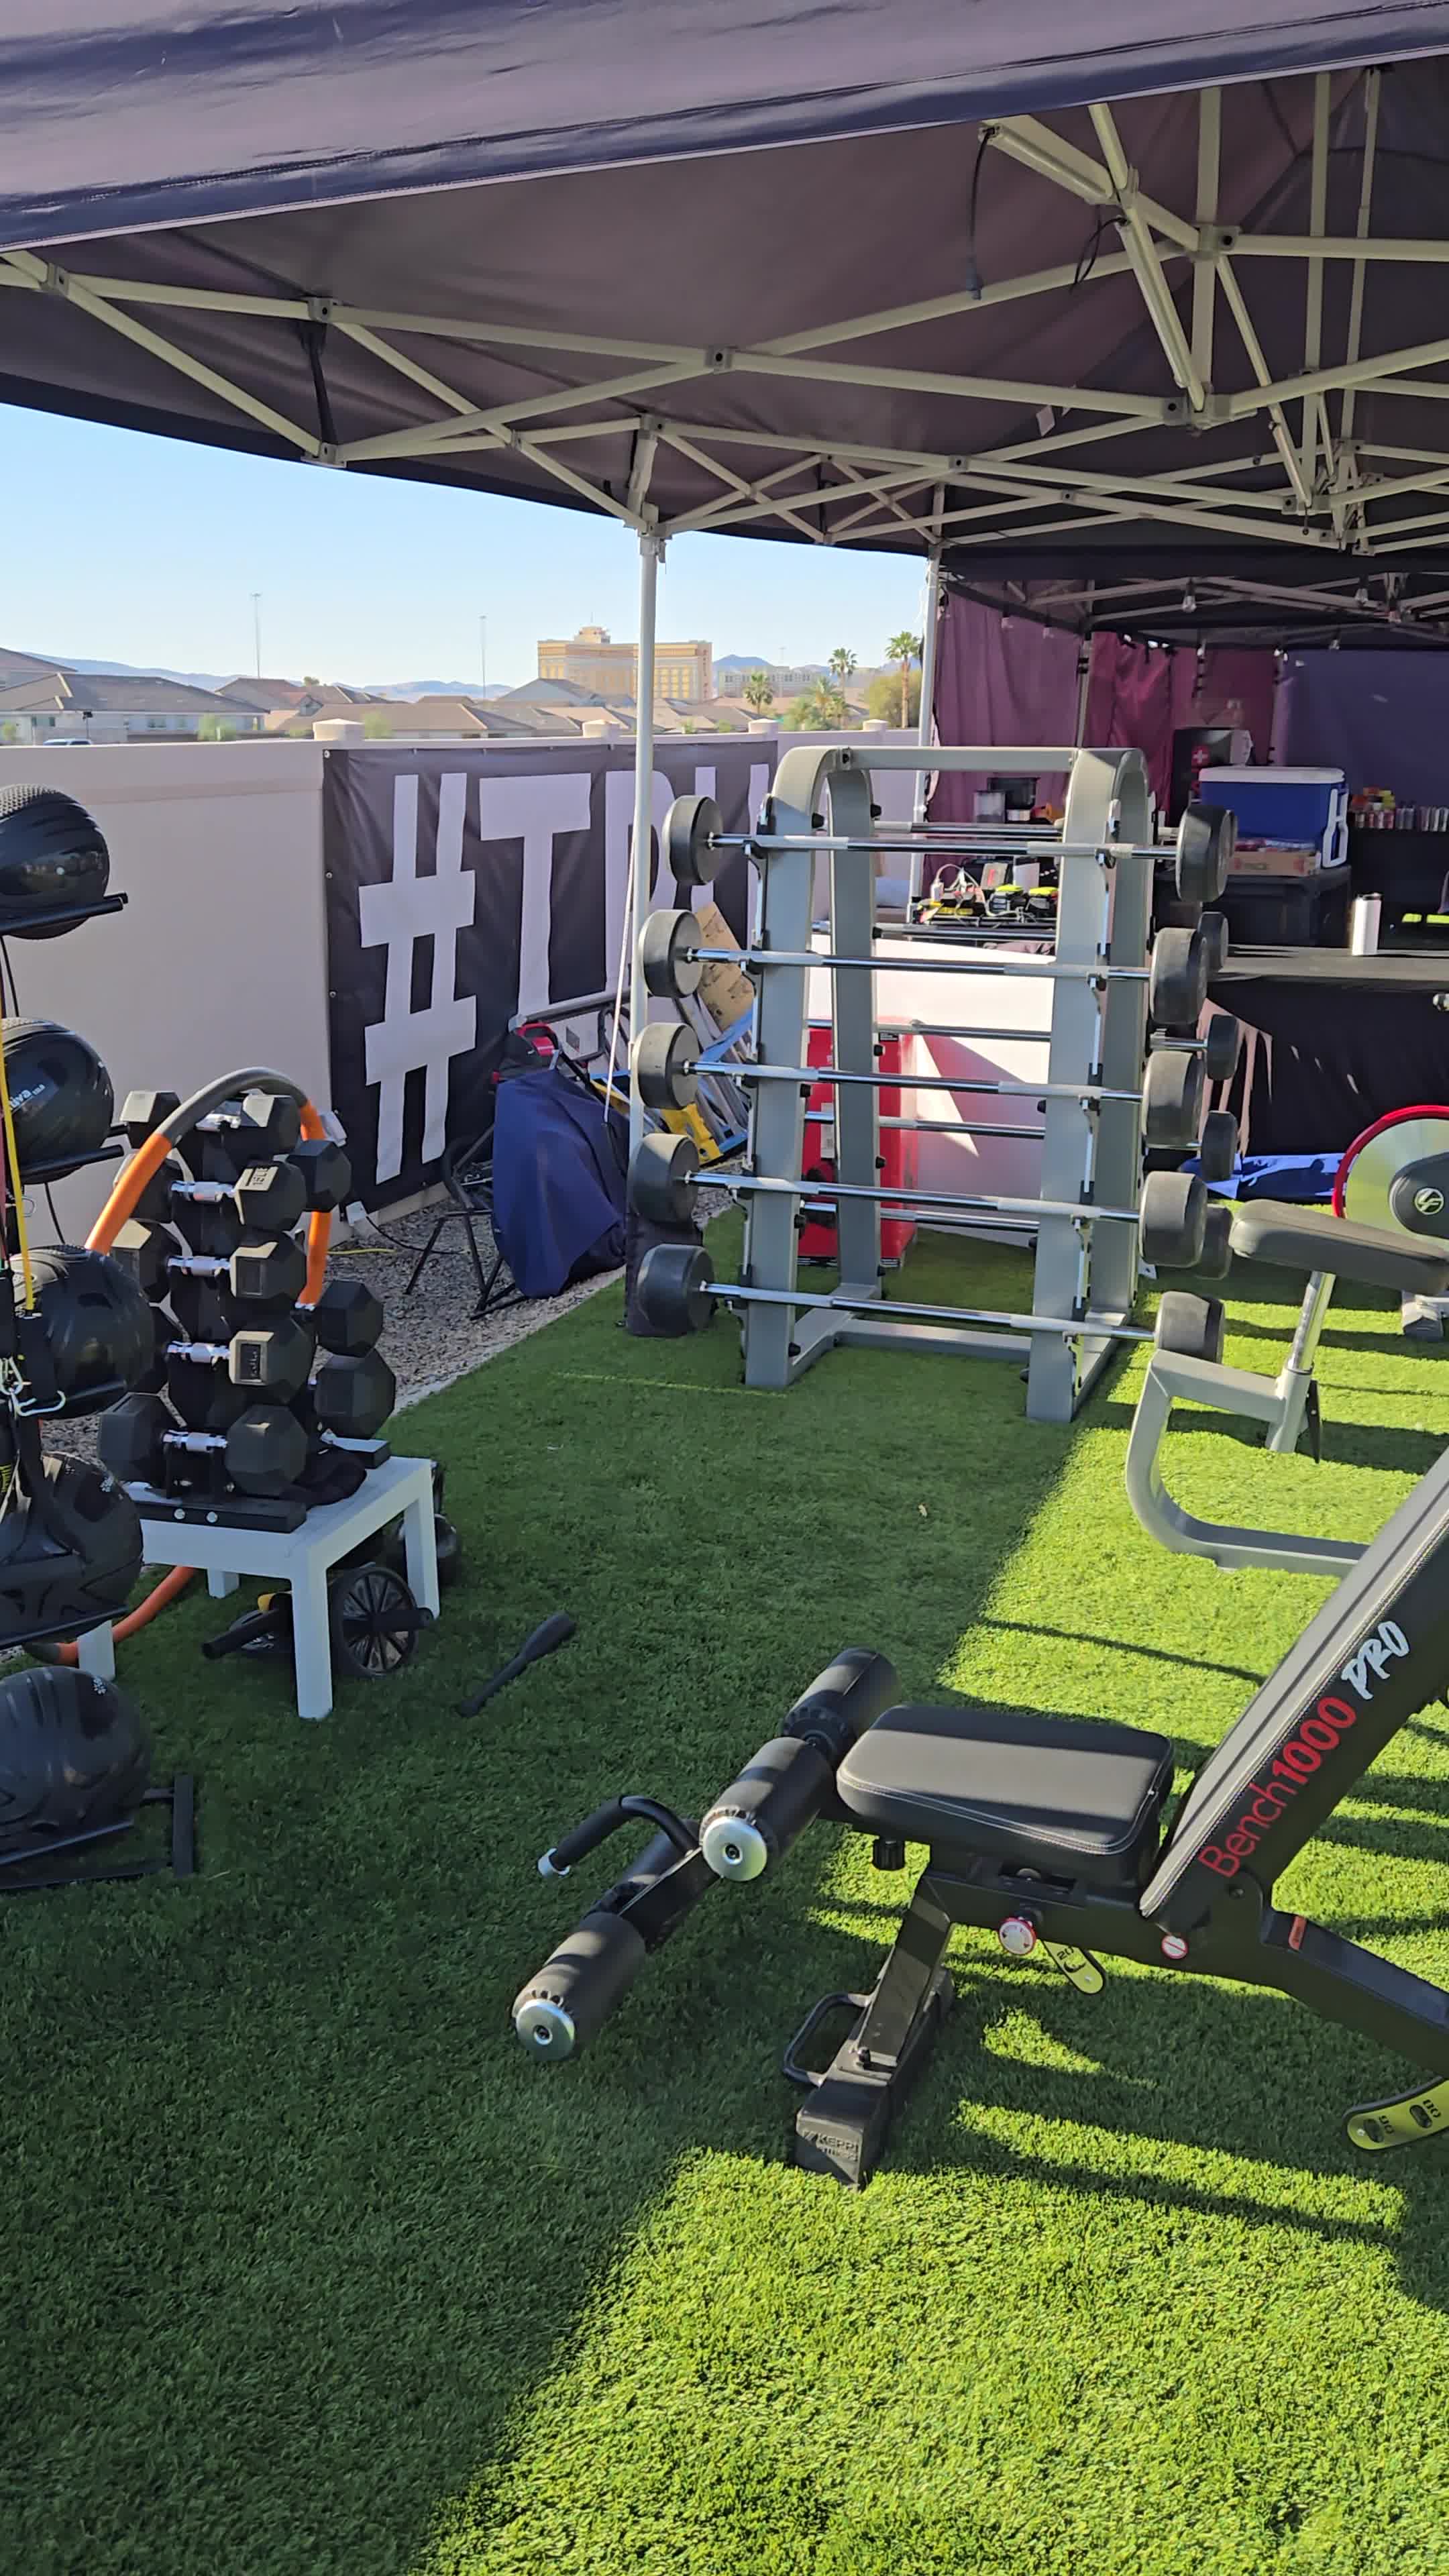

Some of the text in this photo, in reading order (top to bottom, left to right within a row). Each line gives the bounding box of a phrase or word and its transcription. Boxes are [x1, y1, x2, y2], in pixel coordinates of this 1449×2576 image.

[1198, 1621, 1409, 1878] Bench1000 PRO
[1057, 1946, 1074, 1961] 20
